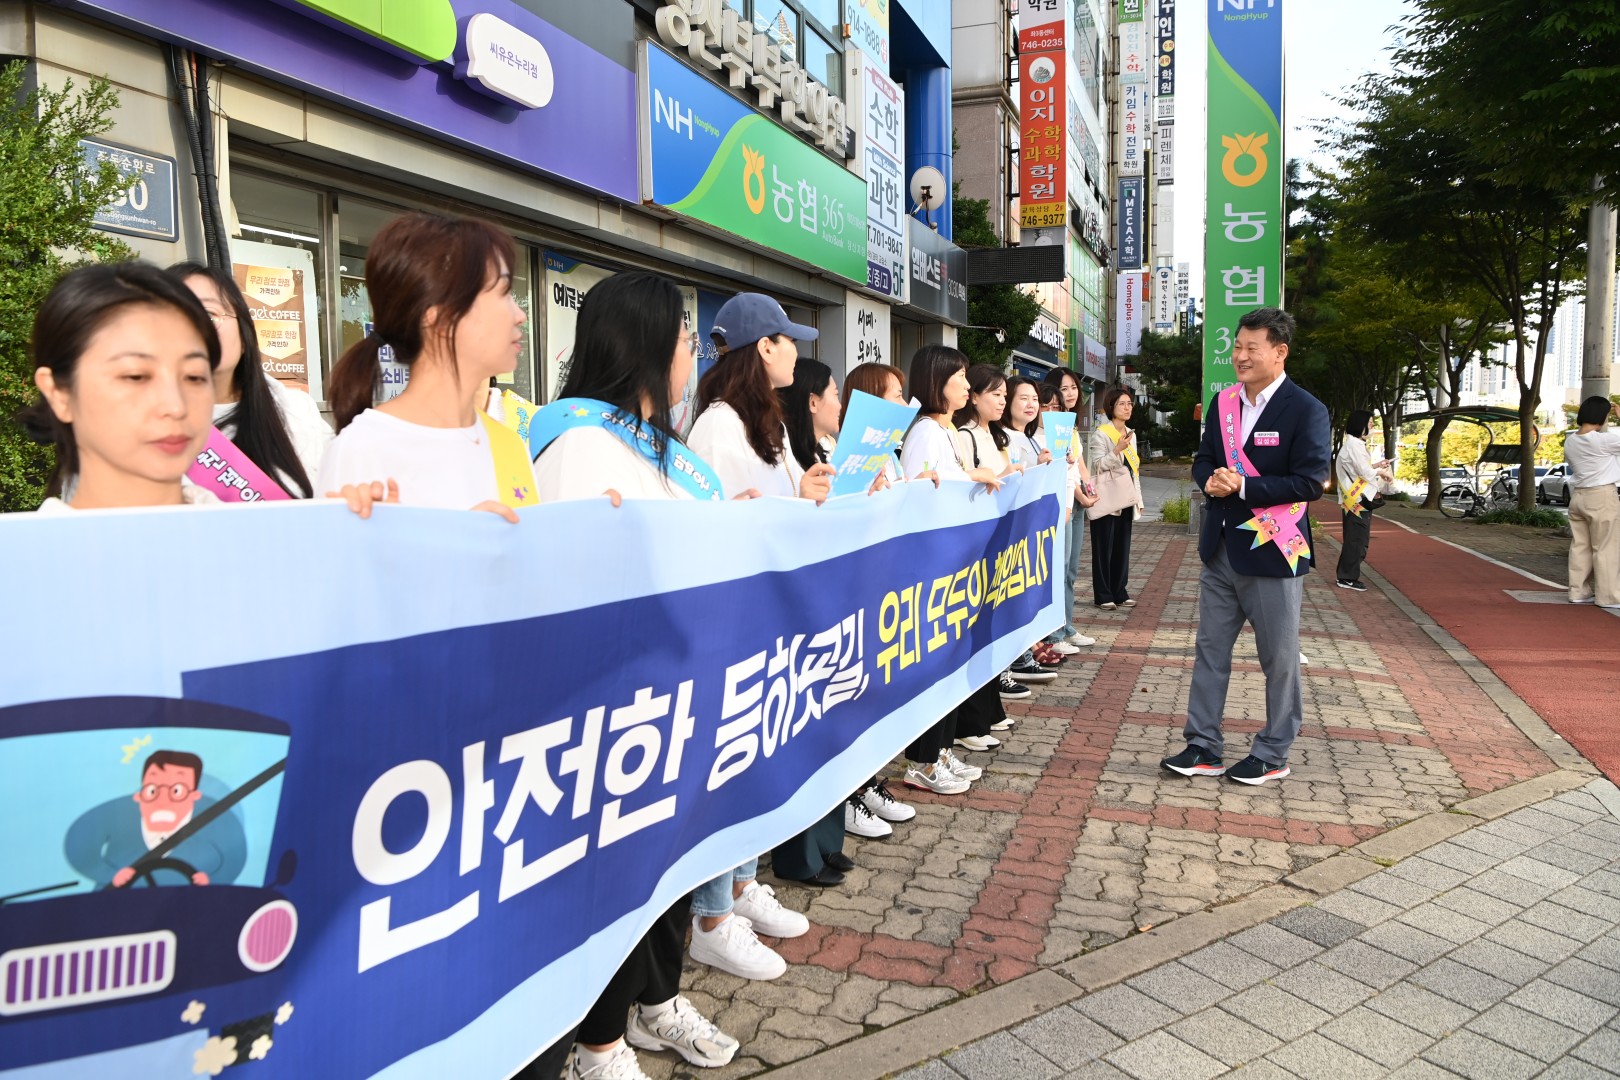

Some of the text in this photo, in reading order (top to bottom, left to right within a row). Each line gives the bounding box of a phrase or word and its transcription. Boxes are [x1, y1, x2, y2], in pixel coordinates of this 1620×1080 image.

[1224, 12, 1268, 21] NongHyup
[489, 42, 538, 79] 씨유온누리점
[1022, 38, 1063, 50] 746-0235
[654, 88, 693, 140] NH
[869, 92, 899, 155] 수학
[1030, 87, 1055, 122] 이지
[1024, 125, 1061, 144] 수학
[1024, 144, 1061, 162] 과학
[772, 164, 844, 235] 농협 365
[869, 168, 900, 228] 과학
[1029, 163, 1058, 200] 학원
[1022, 213, 1065, 226] 746-9377
[1125, 198, 1134, 255] MECA수학
[911, 246, 941, 291] 엠베스트
[1221, 202, 1267, 306] 농협
[1125, 278, 1134, 321] Homeplus
[351, 679, 695, 974] 안전한
[876, 581, 924, 685] 우리
[926, 557, 988, 654] 모두의
